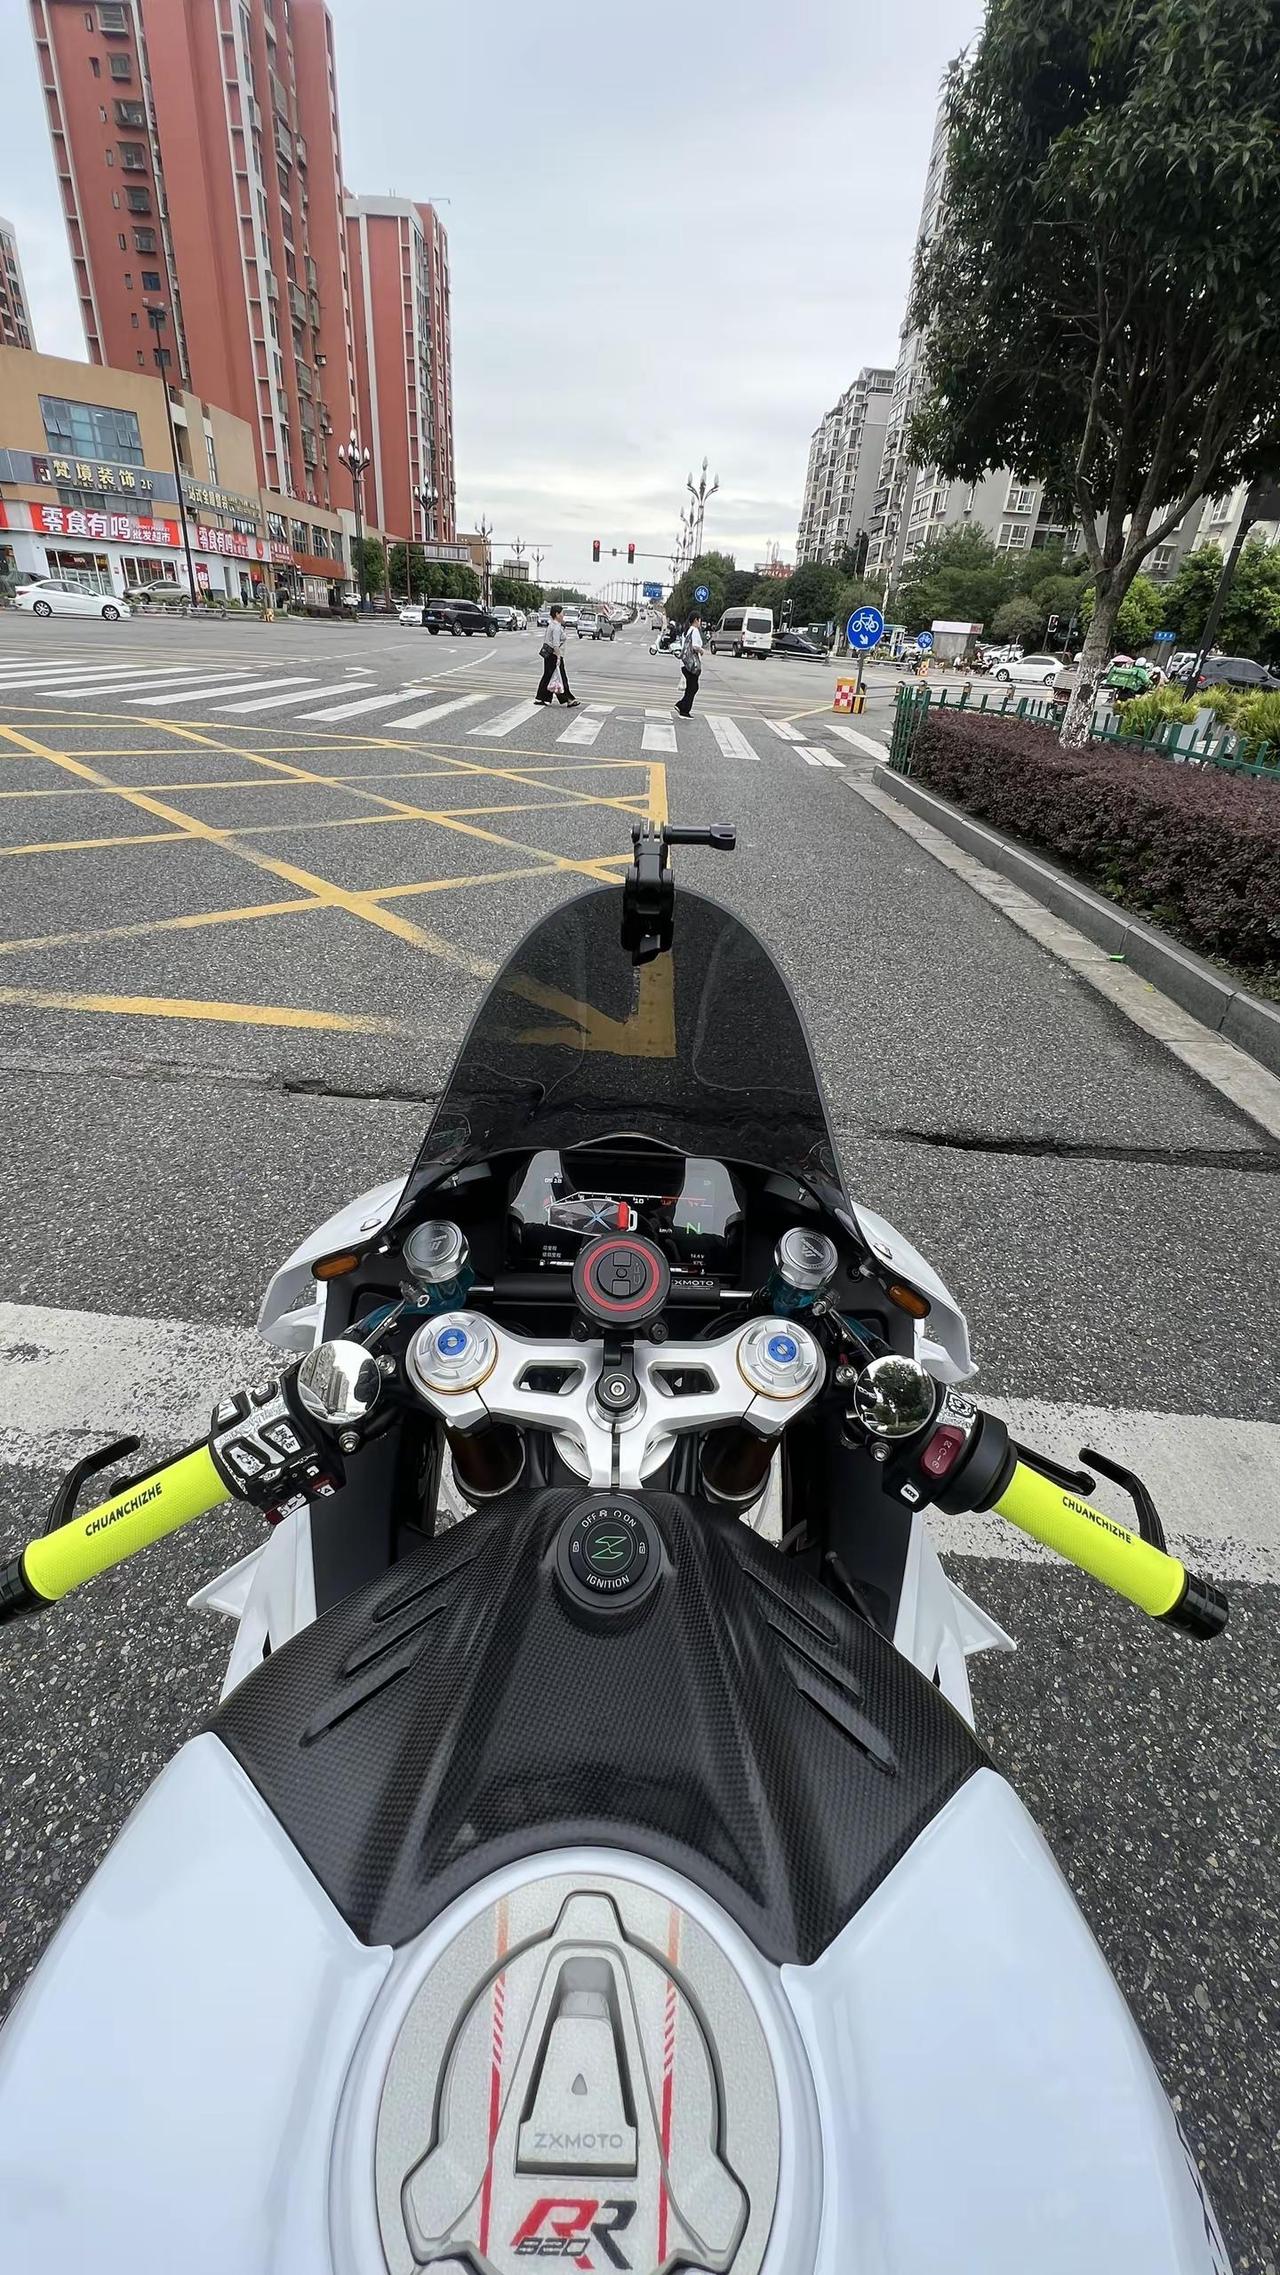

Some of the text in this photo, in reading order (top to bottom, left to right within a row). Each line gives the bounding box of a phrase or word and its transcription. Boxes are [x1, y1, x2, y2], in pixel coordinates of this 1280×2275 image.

[53, 460, 136, 488] 梵境装饰
[42, 507, 131, 539] 零食有鸣
[132, 529, 170, 543] 批发超市
[687, 1222, 701, 1234] N
[85, 1482, 163, 1537] CHUANCHIZHE
[581, 1512, 597, 1528] OFF
[623, 1514, 637, 1527] ON
[1062, 1496, 1132, 1544] CHUANCHIZHE
[586, 1573, 630, 1589] IGNITION
[534, 2133, 623, 2149] ZXMOTO
[514, 2236, 590, 2256] 820
